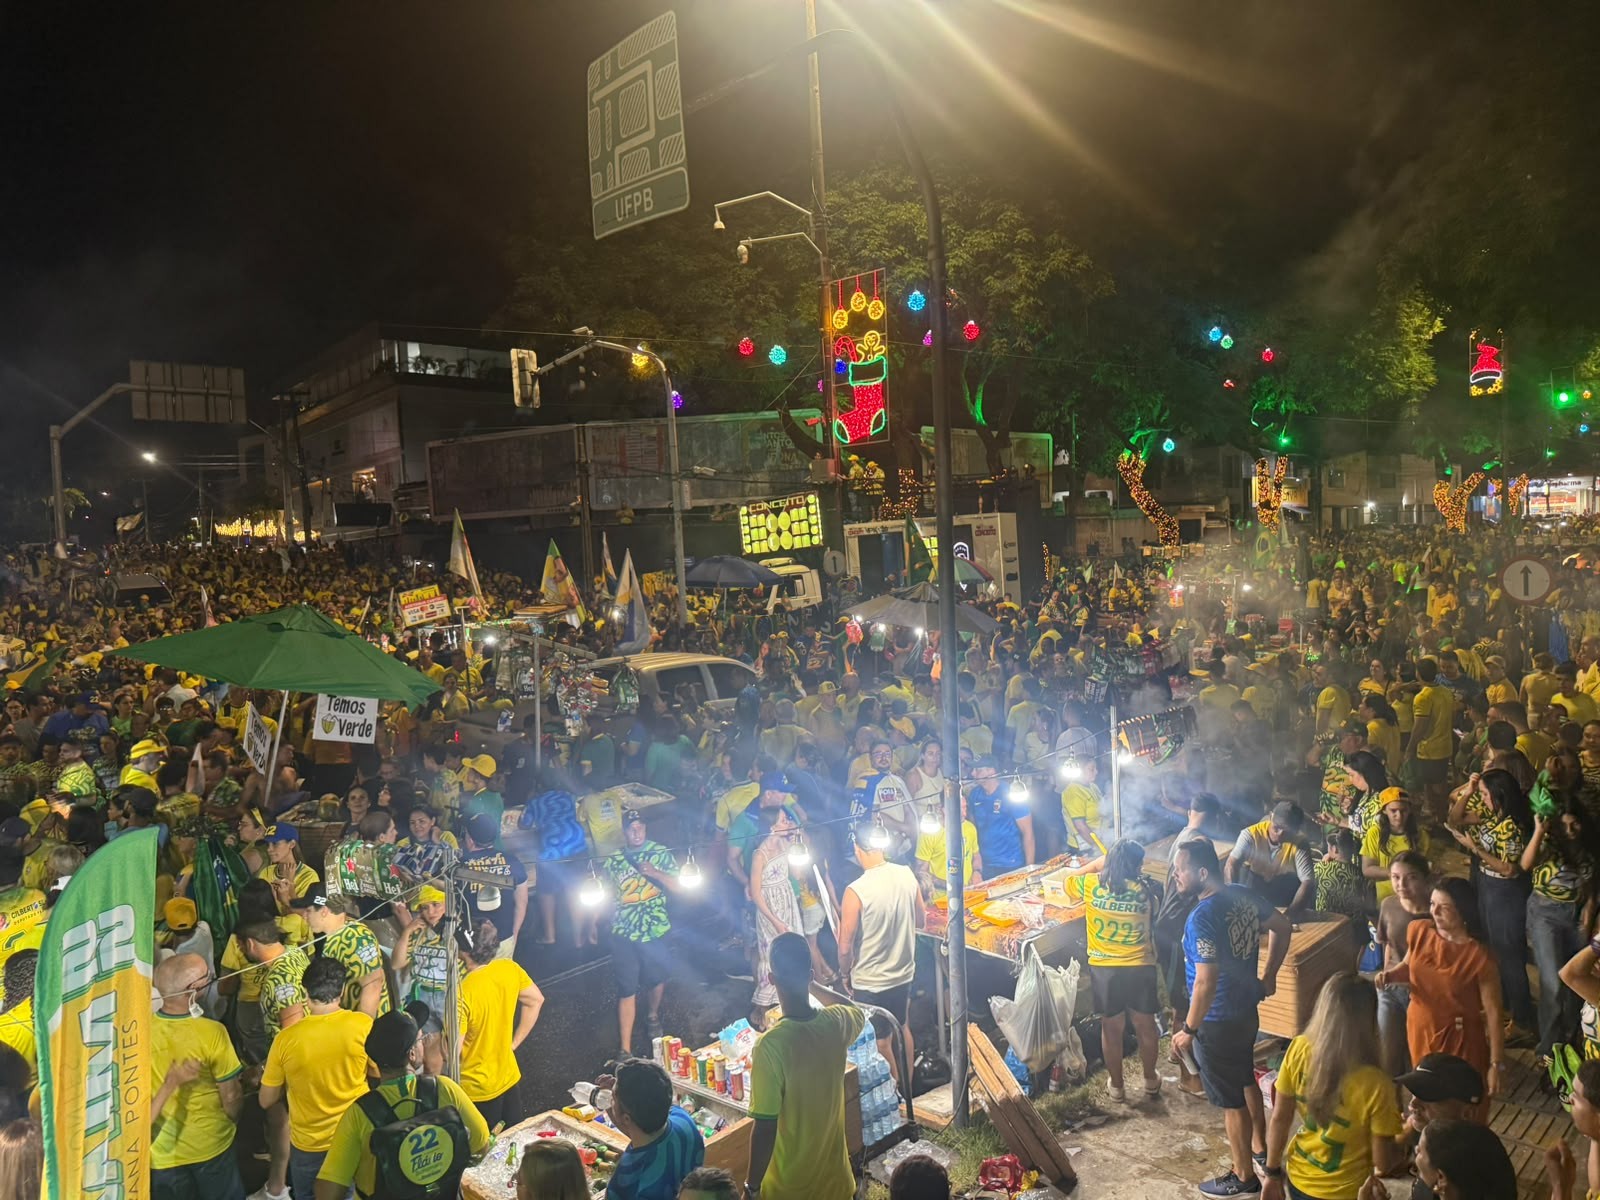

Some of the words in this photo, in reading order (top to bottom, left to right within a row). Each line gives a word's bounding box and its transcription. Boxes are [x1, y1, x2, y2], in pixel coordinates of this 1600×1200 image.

[615, 187, 653, 222] UFPB
[749, 495, 805, 512] CONCEITO
[326, 694, 366, 715] Temos
[338, 718, 373, 738] Verde
[314, 895, 327, 906] 22
[121, 1018, 139, 1125] PONTES
[410, 1128, 439, 1155] 22
